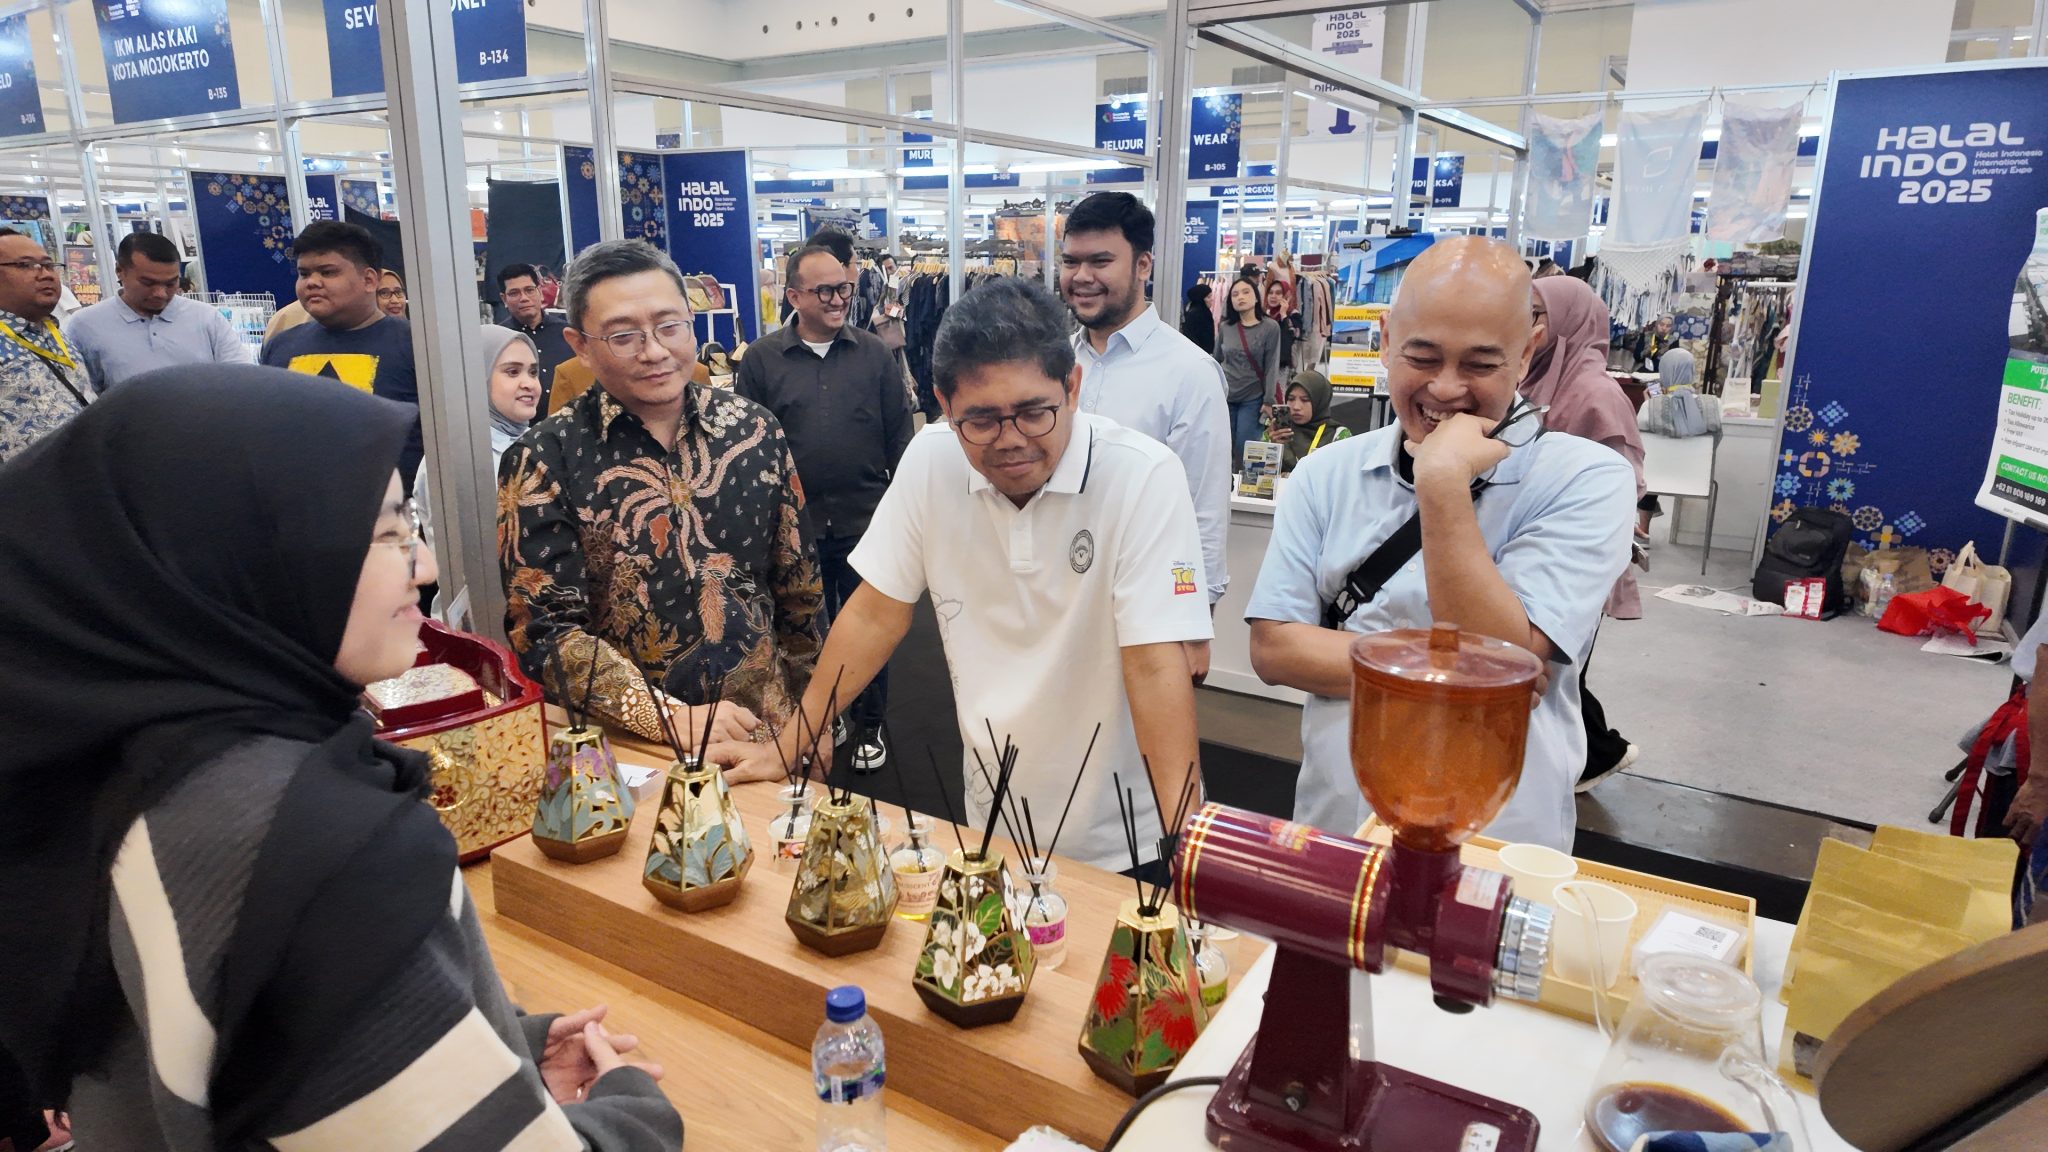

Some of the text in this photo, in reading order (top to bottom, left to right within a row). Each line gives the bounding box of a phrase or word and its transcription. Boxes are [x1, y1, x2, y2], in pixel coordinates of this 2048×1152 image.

[344, 4, 379, 30] SEV
[114, 25, 198, 57] IKM ALAS KAKI
[1336, 29, 1361, 39] 2025
[112, 48, 210, 81] KOTA MOJOKERTO
[479, 48, 509, 66] B-134
[1102, 138, 1144, 151] JELUJUR
[1193, 133, 1228, 146] WEAR
[2001, 149, 2044, 157] Indonesia
[1972, 165, 2033, 176] Industry Expo
[1973, 158, 2029, 167] International
[1897, 178, 1993, 204] 2025
[693, 212, 725, 228] 2025
[2000, 462, 2029, 477] CONTACT
[2028, 470, 2037, 480] US
